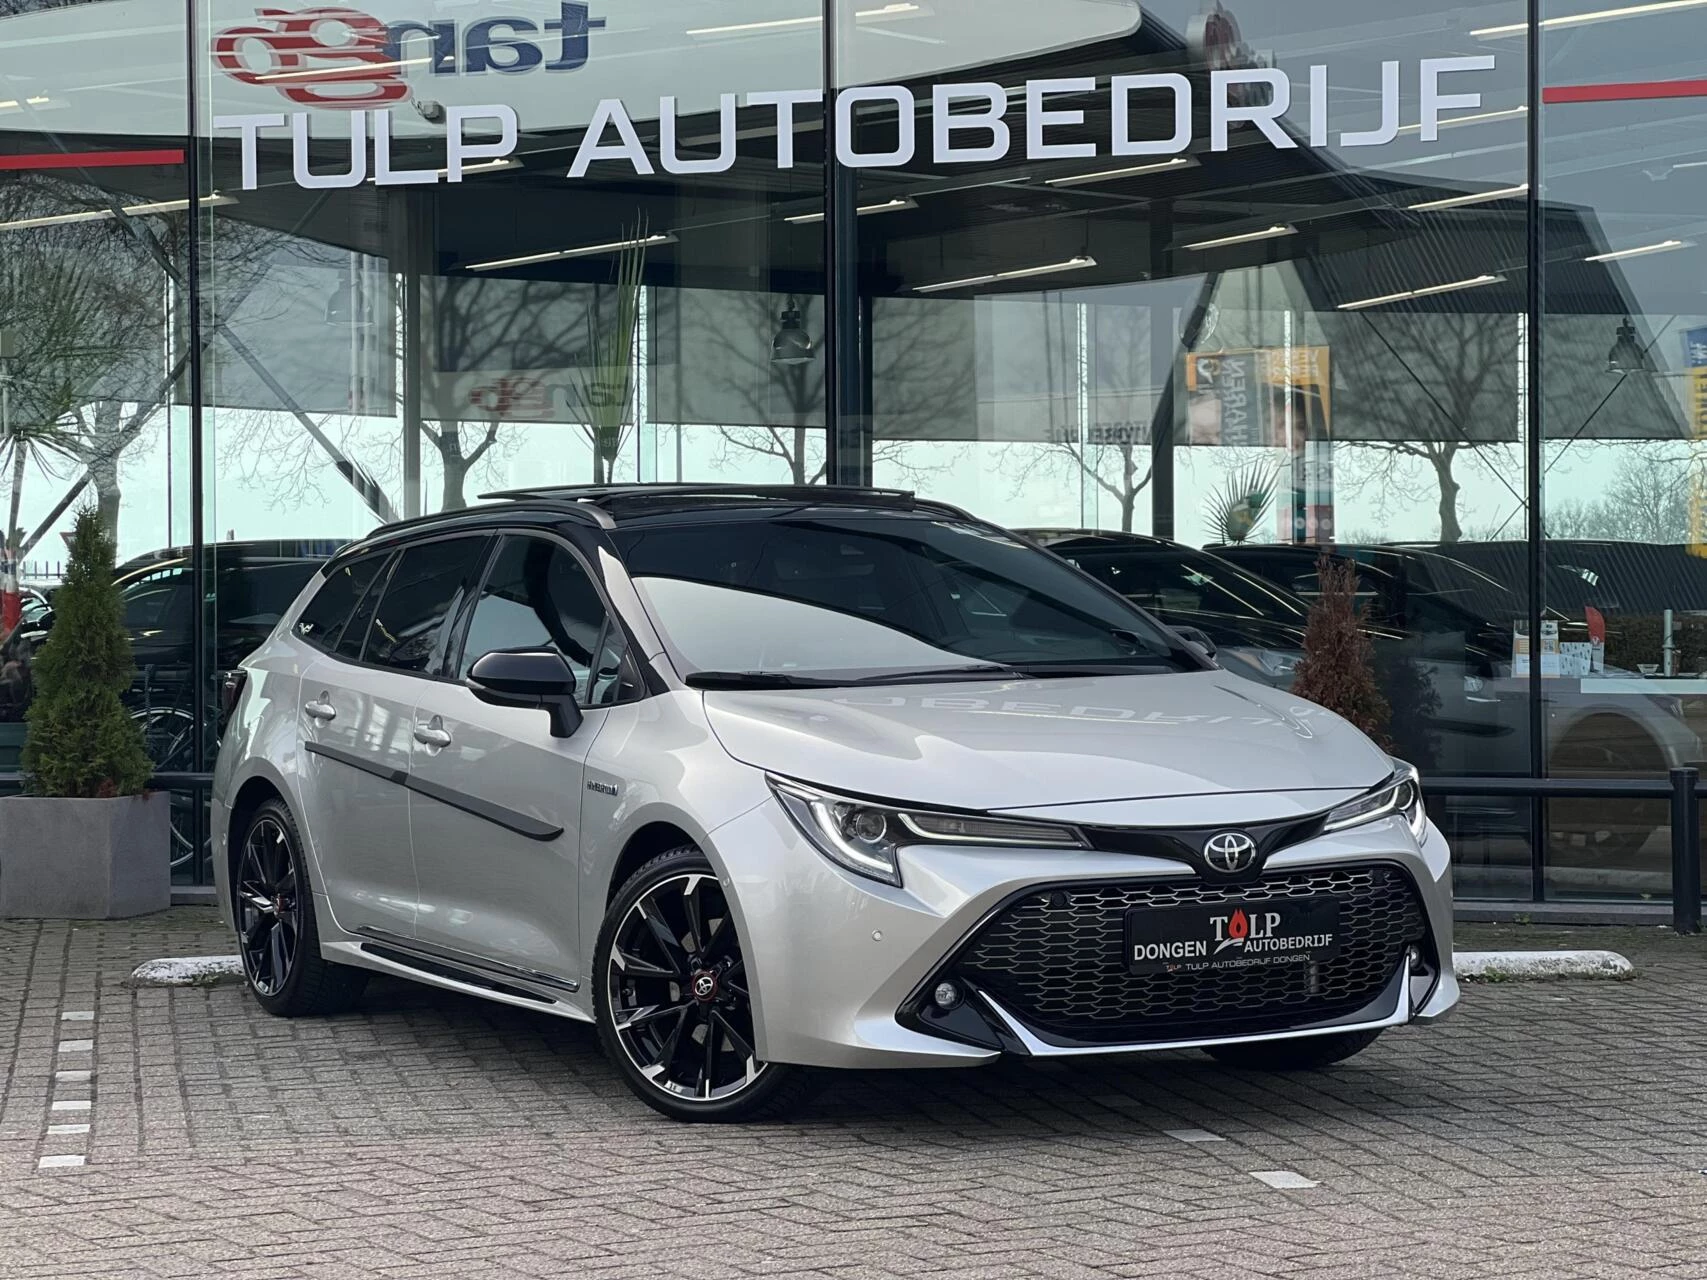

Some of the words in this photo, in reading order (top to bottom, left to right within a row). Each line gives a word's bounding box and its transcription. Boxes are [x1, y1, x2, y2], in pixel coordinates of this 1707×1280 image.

[213, 104, 518, 190] TULP
[567, 55, 1497, 178] AUTOBEDRIJF
[1134, 940, 1207, 961] DONGEN
[1243, 934, 1333, 953] AUTOBEDRIJF
[1186, 962, 1209, 971] TULP
[1211, 957, 1272, 970] AUTOBEDRIJF
[1273, 954, 1311, 965] DONGEN
